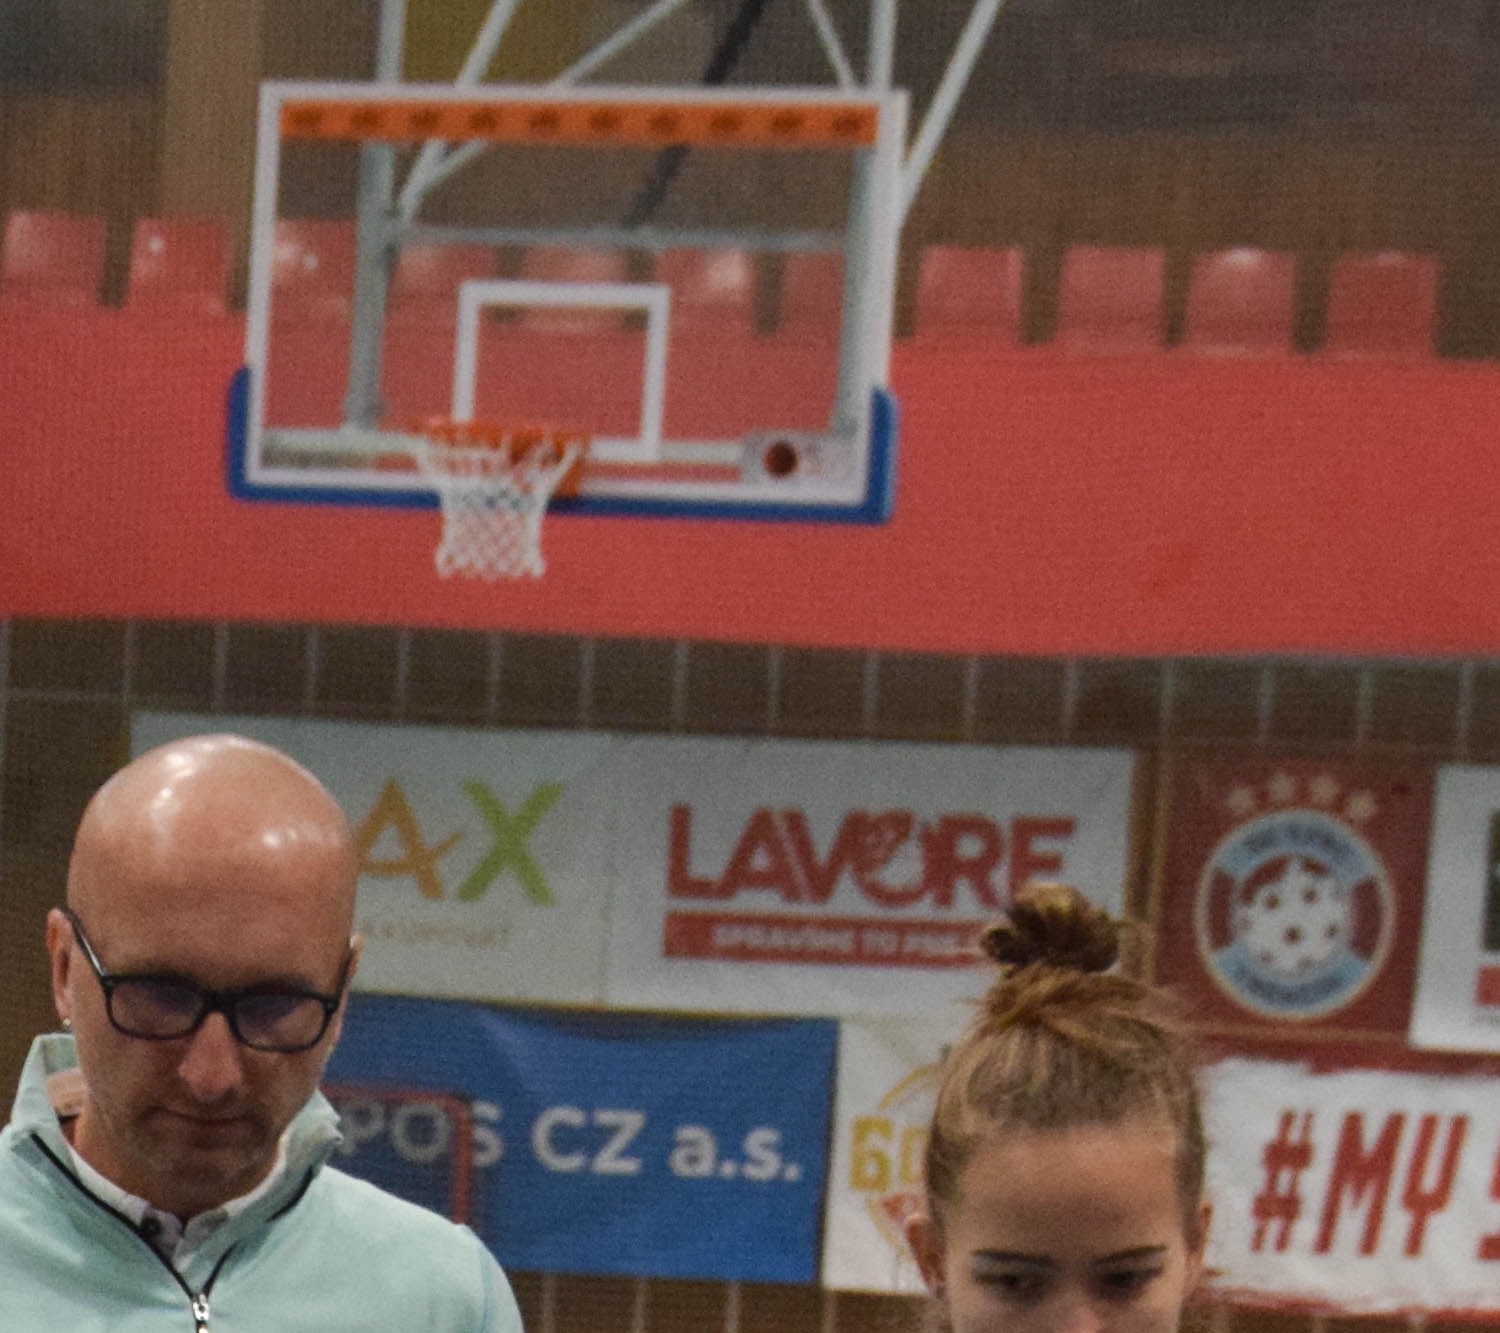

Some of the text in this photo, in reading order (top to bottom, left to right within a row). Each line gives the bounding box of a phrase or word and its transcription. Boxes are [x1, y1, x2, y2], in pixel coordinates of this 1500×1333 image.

[668, 803, 1077, 908] LAVORE
[530, 1105, 648, 1176] CZ
[667, 1124, 801, 1182] a.s.
